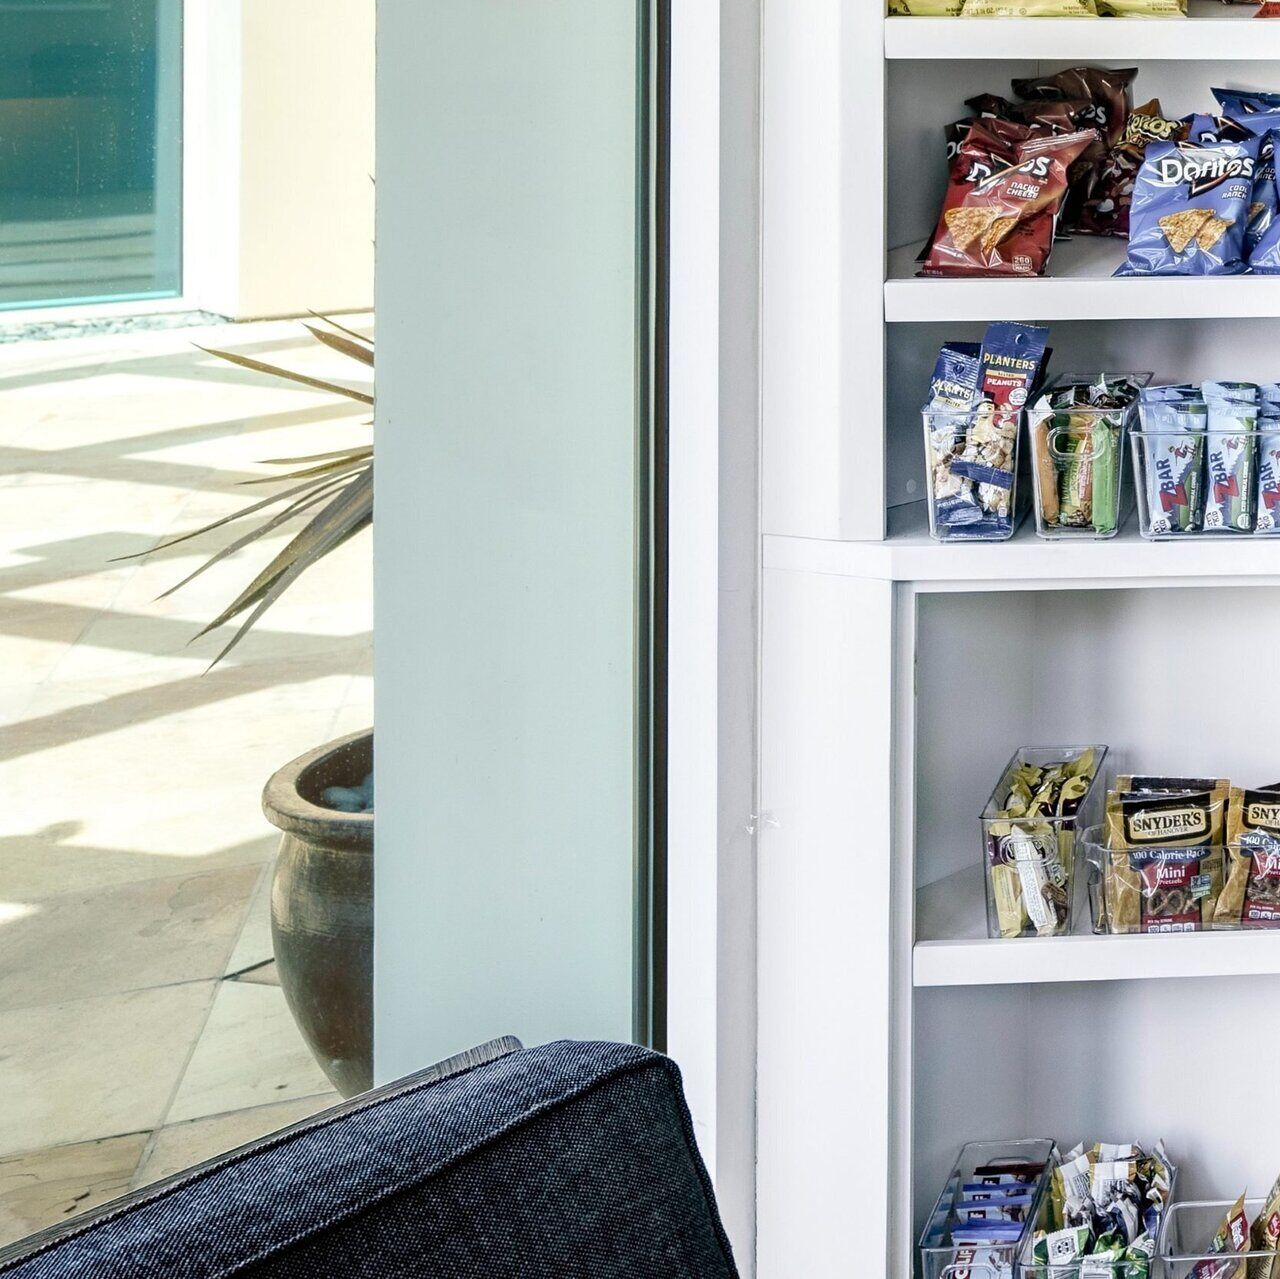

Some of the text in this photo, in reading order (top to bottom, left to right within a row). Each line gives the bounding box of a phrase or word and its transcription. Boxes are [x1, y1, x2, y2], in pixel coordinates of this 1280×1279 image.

[1161, 157, 1255, 184] Doritos
[1010, 181, 1041, 192] NACHO
[1228, 184, 1248, 193] COOL
[1006, 187, 1040, 199] CHEESE
[1221, 192, 1248, 200] RANCH
[983, 352, 1036, 370] PLANTERS
[986, 377, 1022, 388] PEANUTS
[934, 378, 973, 401] PLANTE
[1132, 811, 1203, 833] SNYDER'S
[1149, 849, 1181, 861] Calorie
[1156, 865, 1186, 879] Mini
